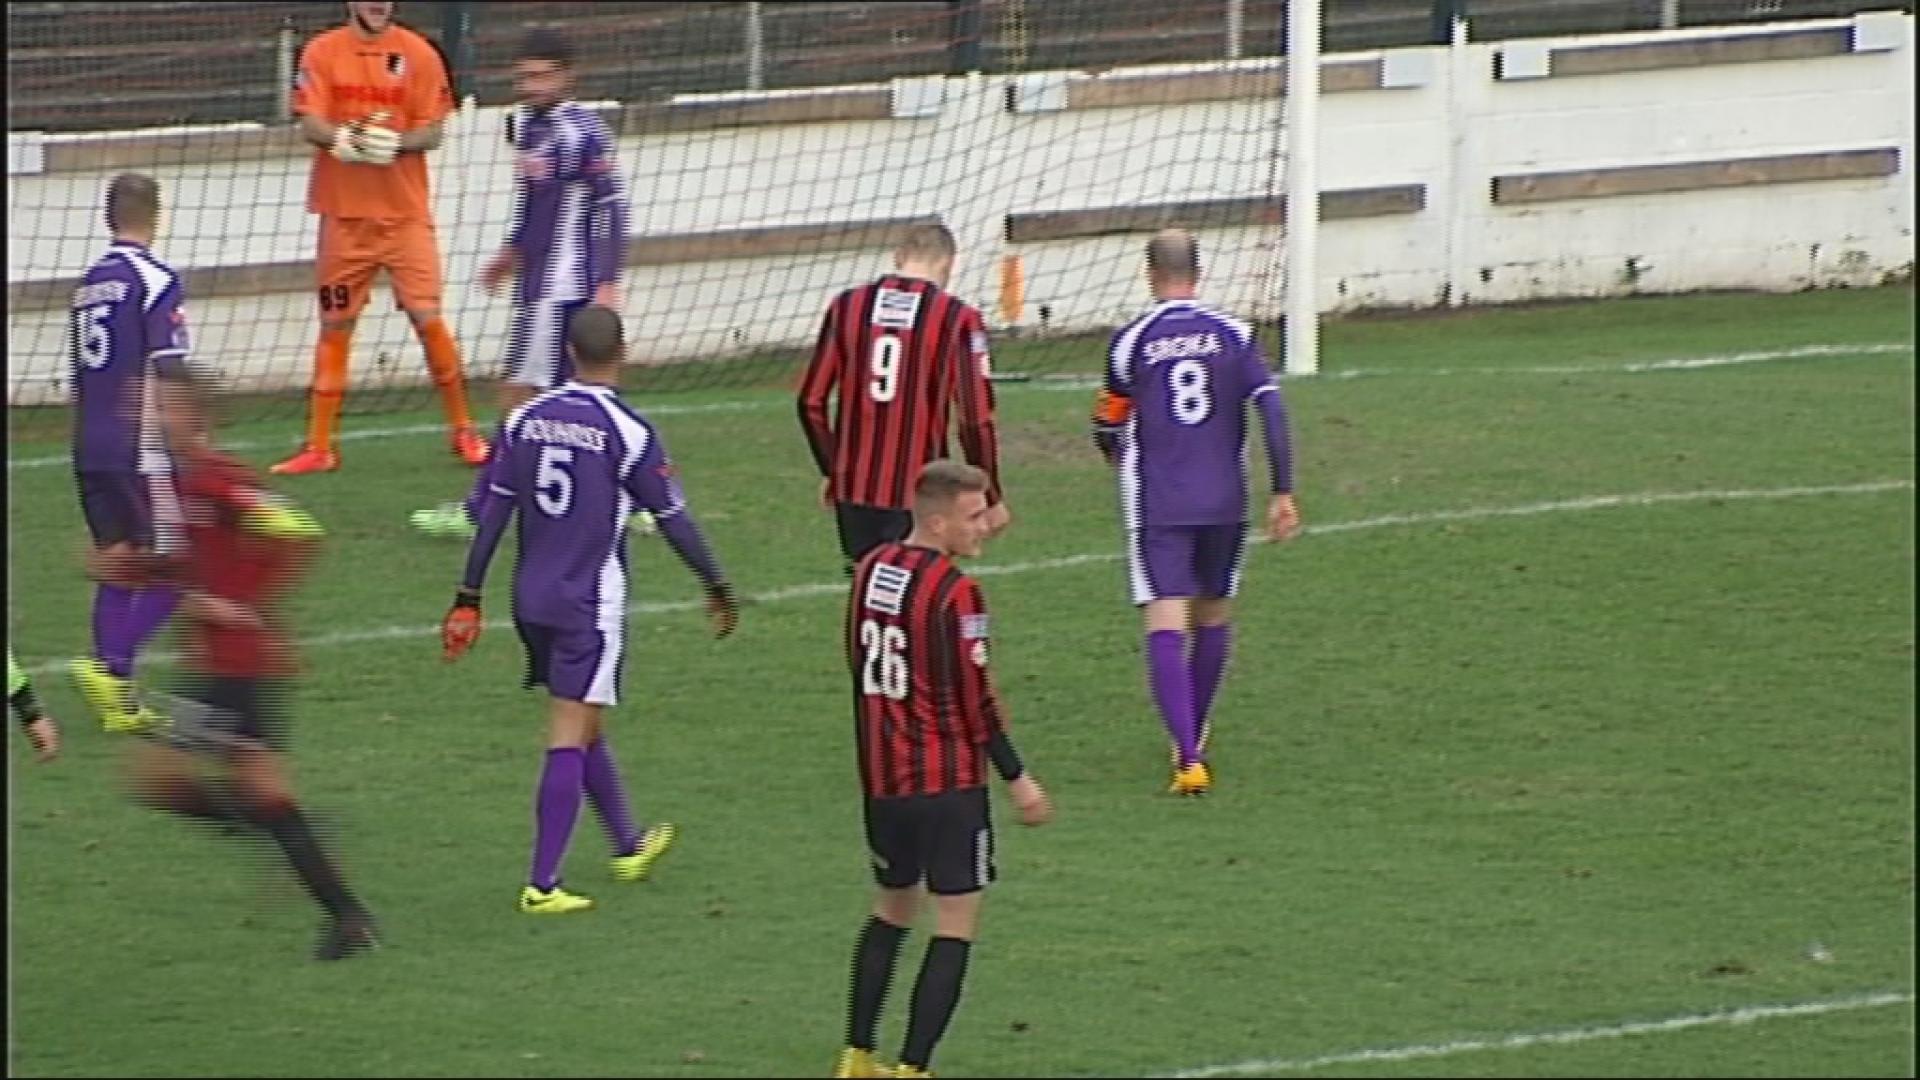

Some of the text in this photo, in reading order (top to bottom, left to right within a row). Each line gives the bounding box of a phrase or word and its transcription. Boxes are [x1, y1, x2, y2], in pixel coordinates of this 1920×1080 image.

[319, 285, 349, 311] 89
[78, 304, 112, 370] 15
[870, 335, 901, 402] 9
[1168, 359, 1211, 424] 8
[535, 445, 574, 515] 5
[861, 619, 908, 699] 26
